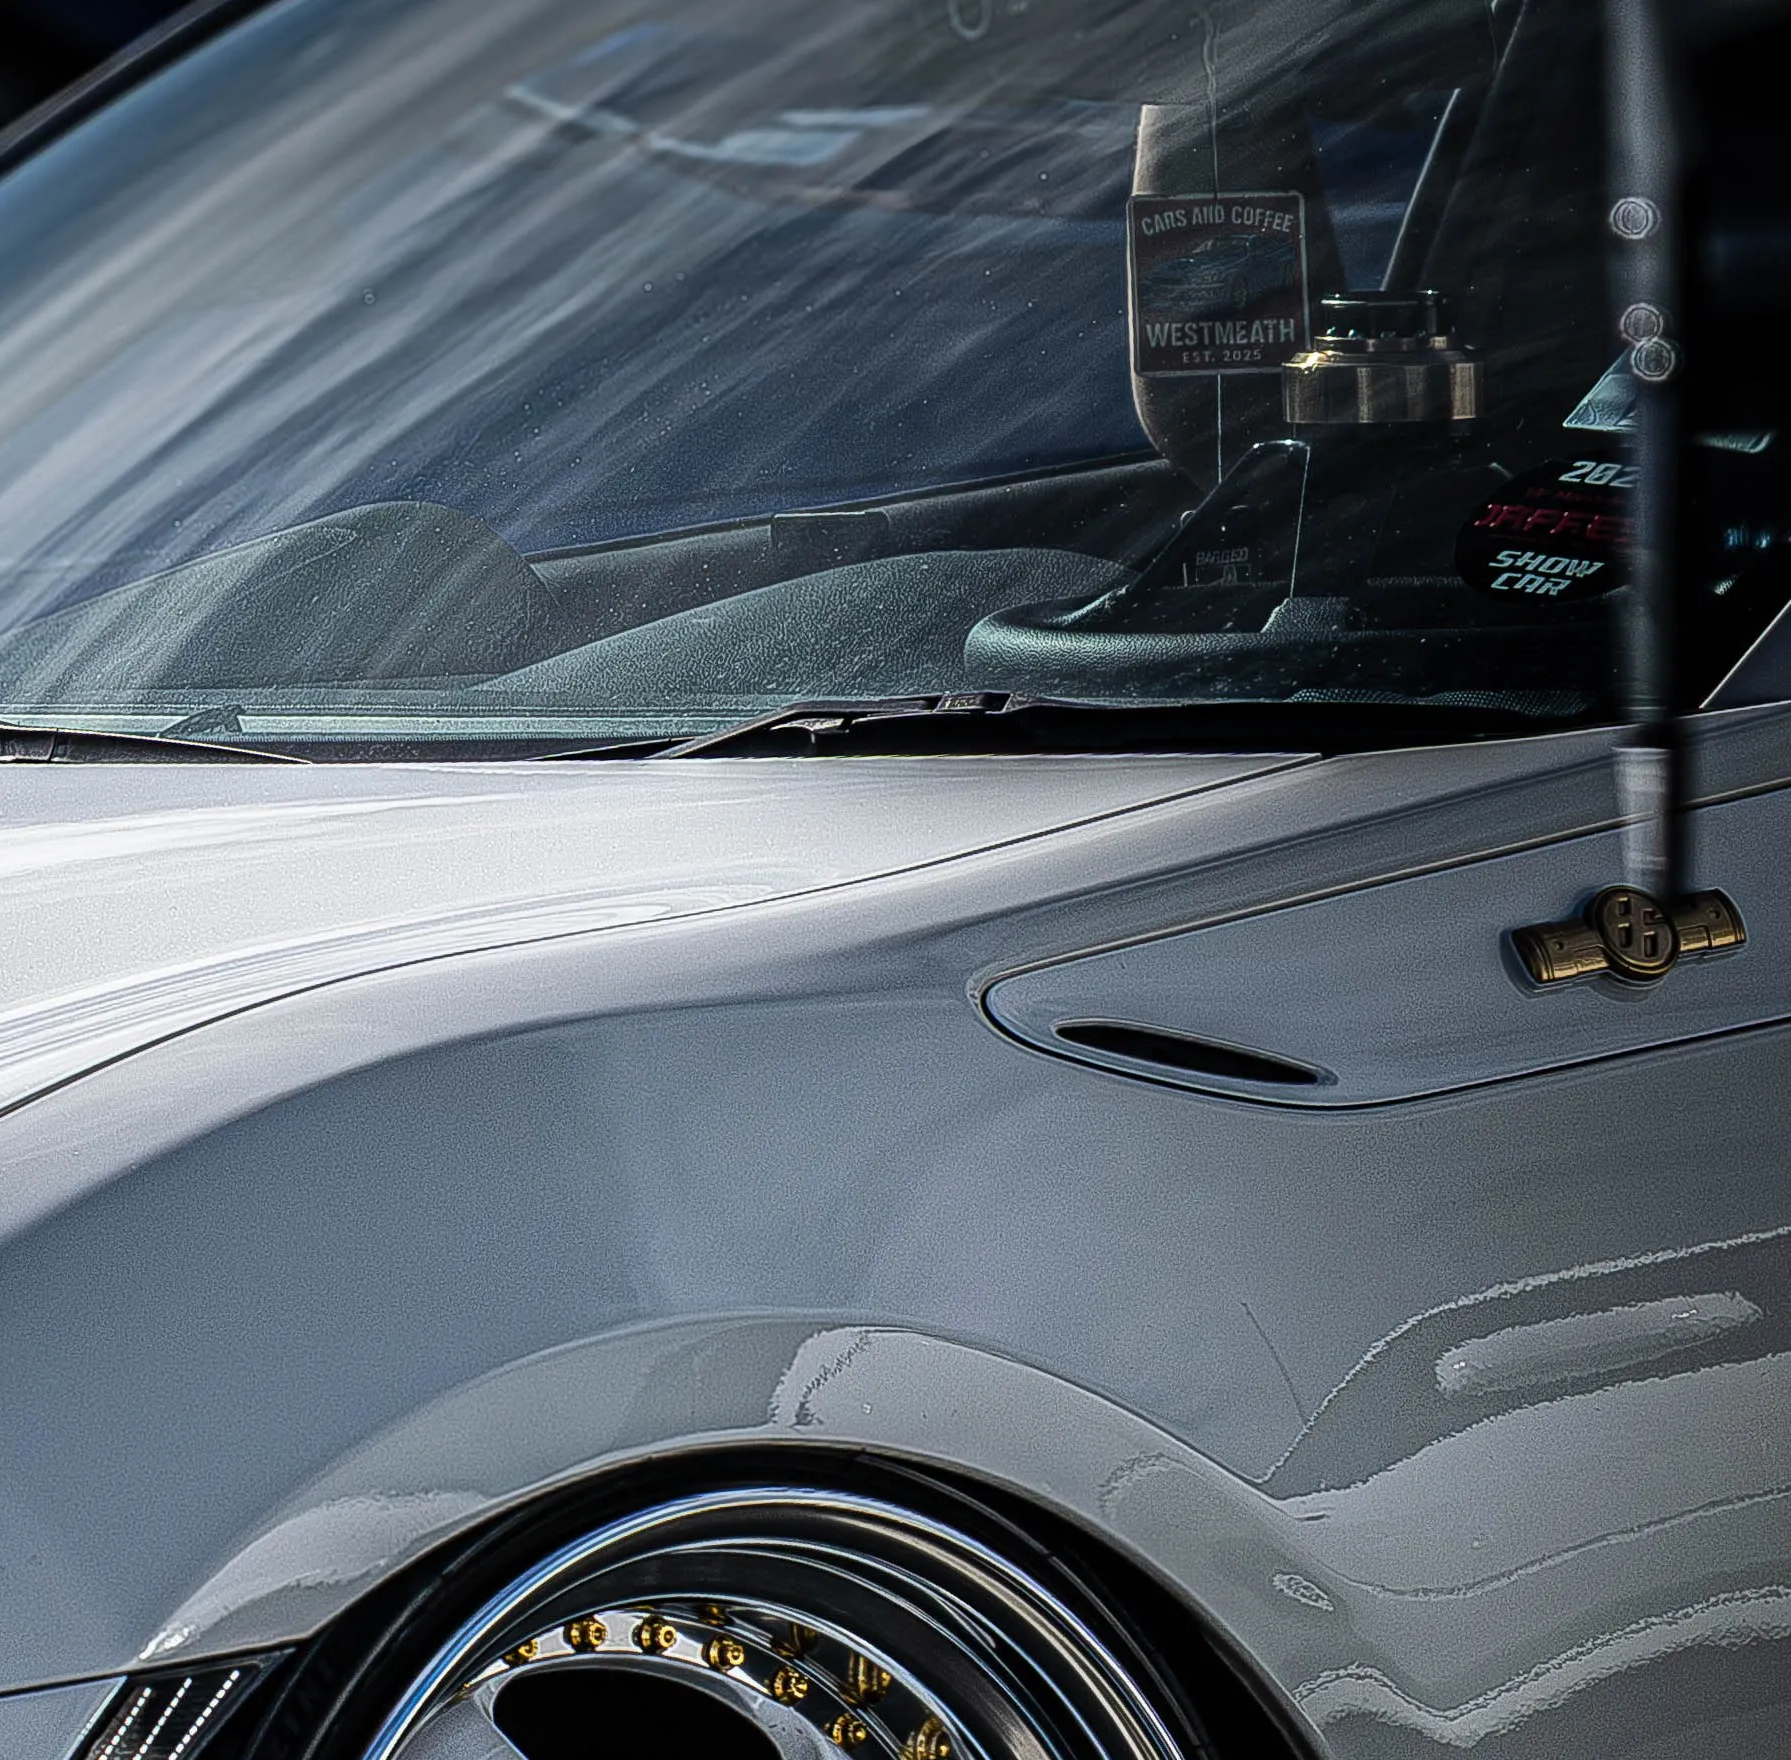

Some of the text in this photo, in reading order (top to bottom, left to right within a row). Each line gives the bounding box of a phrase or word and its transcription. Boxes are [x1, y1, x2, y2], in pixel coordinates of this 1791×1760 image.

[1141, 204, 1295, 237] CARS AND COFFEE
[1146, 318, 1296, 349] WESTMEATH
[1182, 349, 1262, 364] EST. 2025
[1557, 460, 1641, 489] 202
[1488, 549, 1607, 579] SHOW
[1490, 572, 1573, 597] CAR
